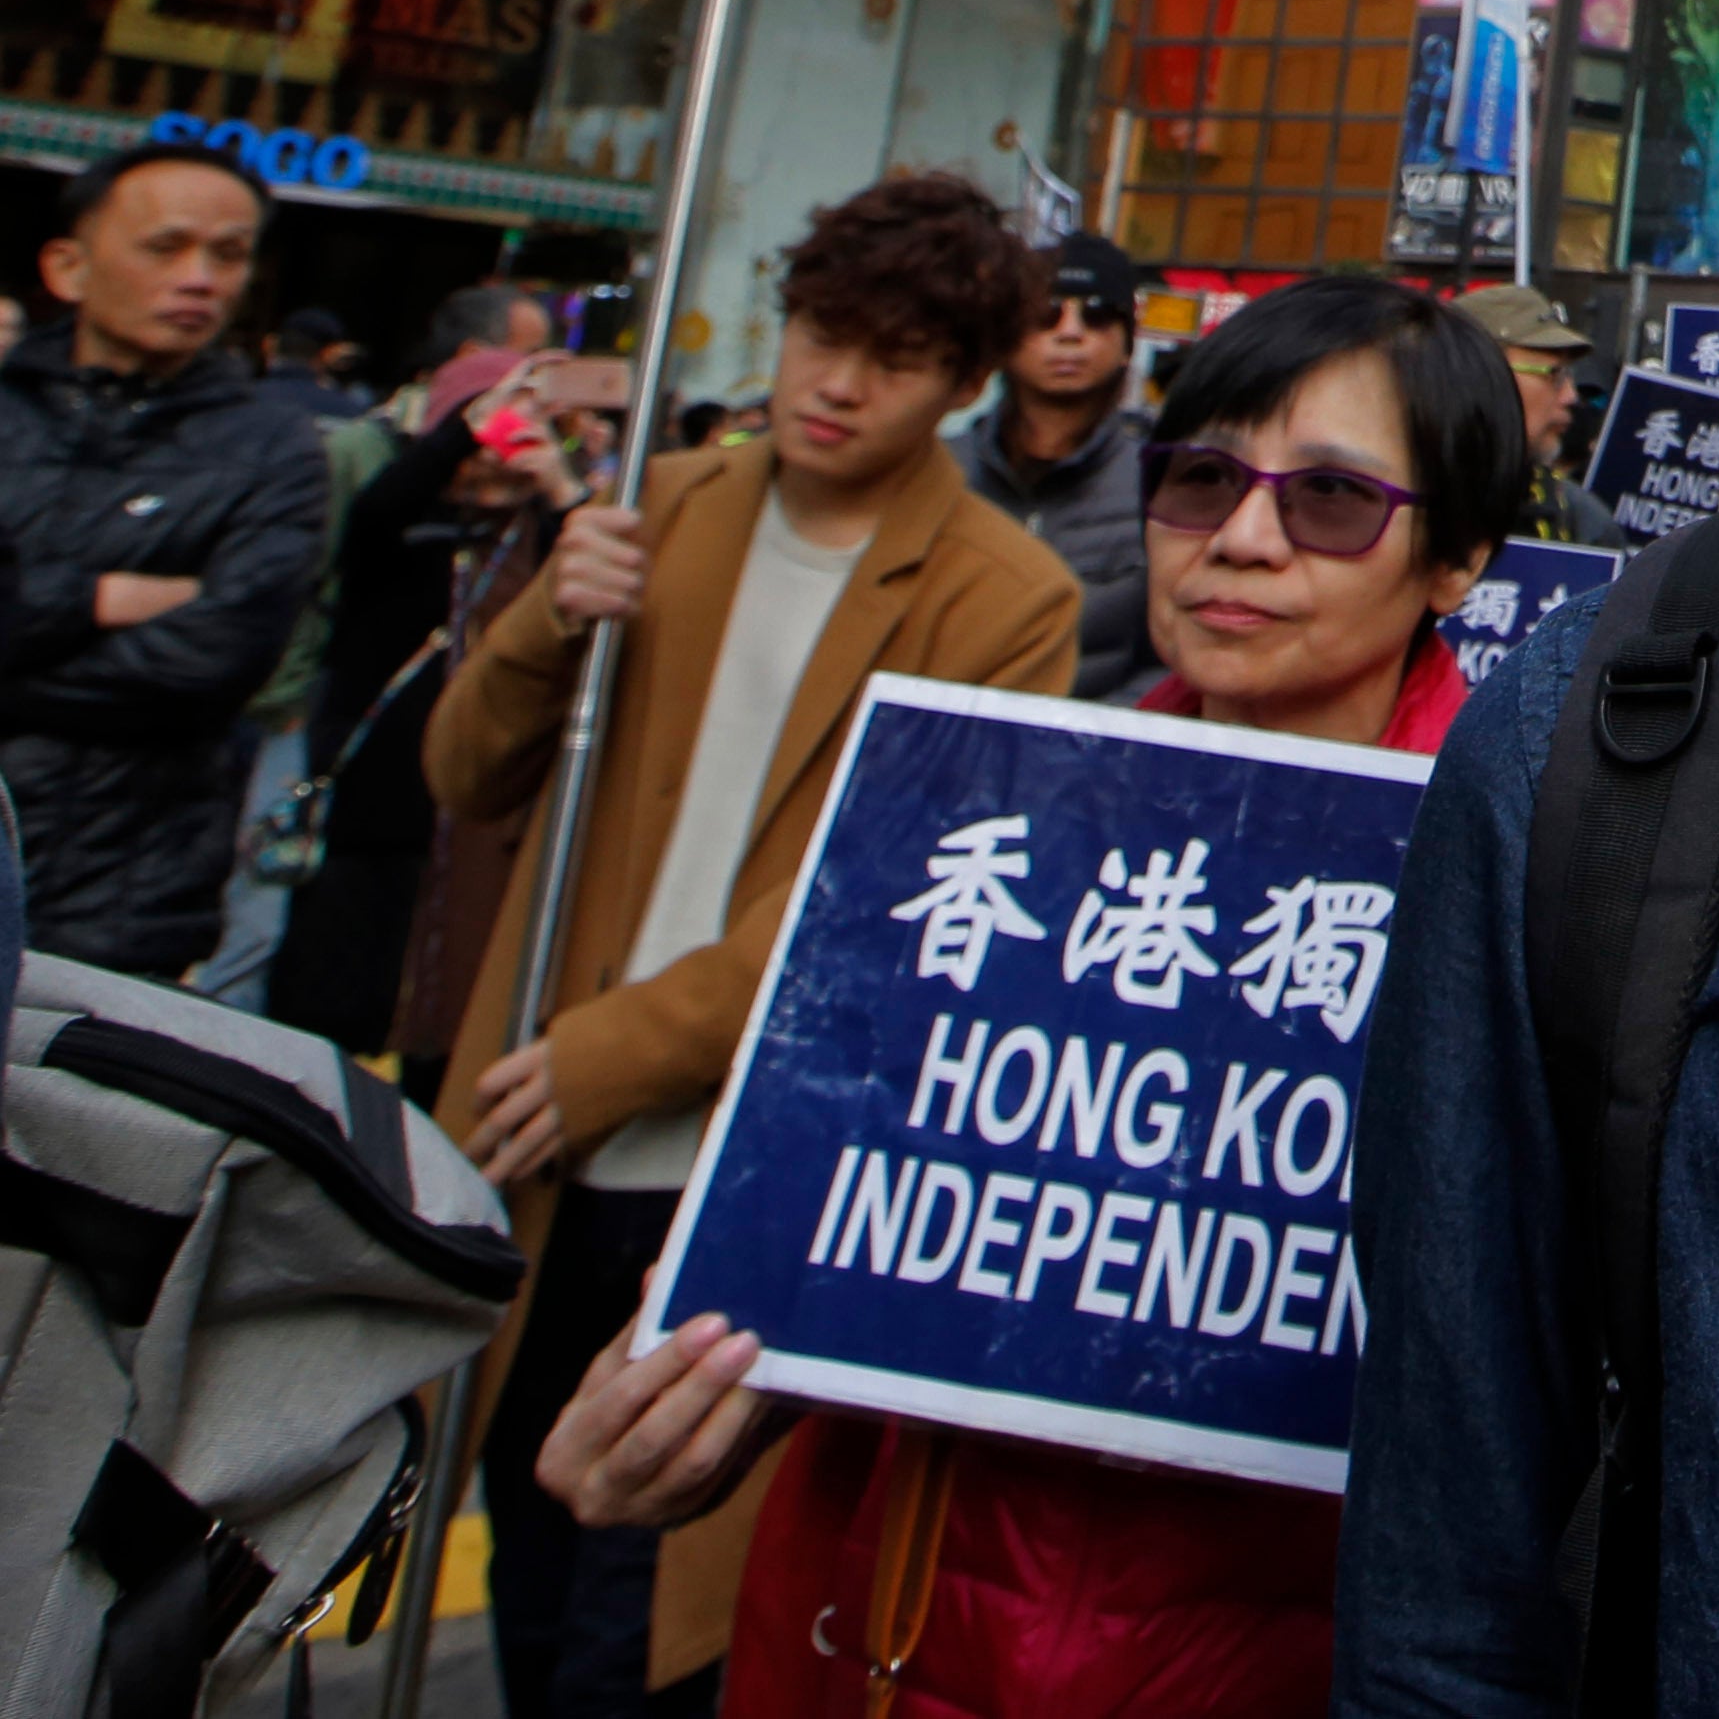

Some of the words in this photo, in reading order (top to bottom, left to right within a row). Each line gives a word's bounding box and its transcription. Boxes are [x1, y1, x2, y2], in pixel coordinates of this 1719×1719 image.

[889, 814, 1397, 1044] 香港獨
[907, 1013, 1191, 1169] HONG
[1203, 1061, 1352, 1204] KO
